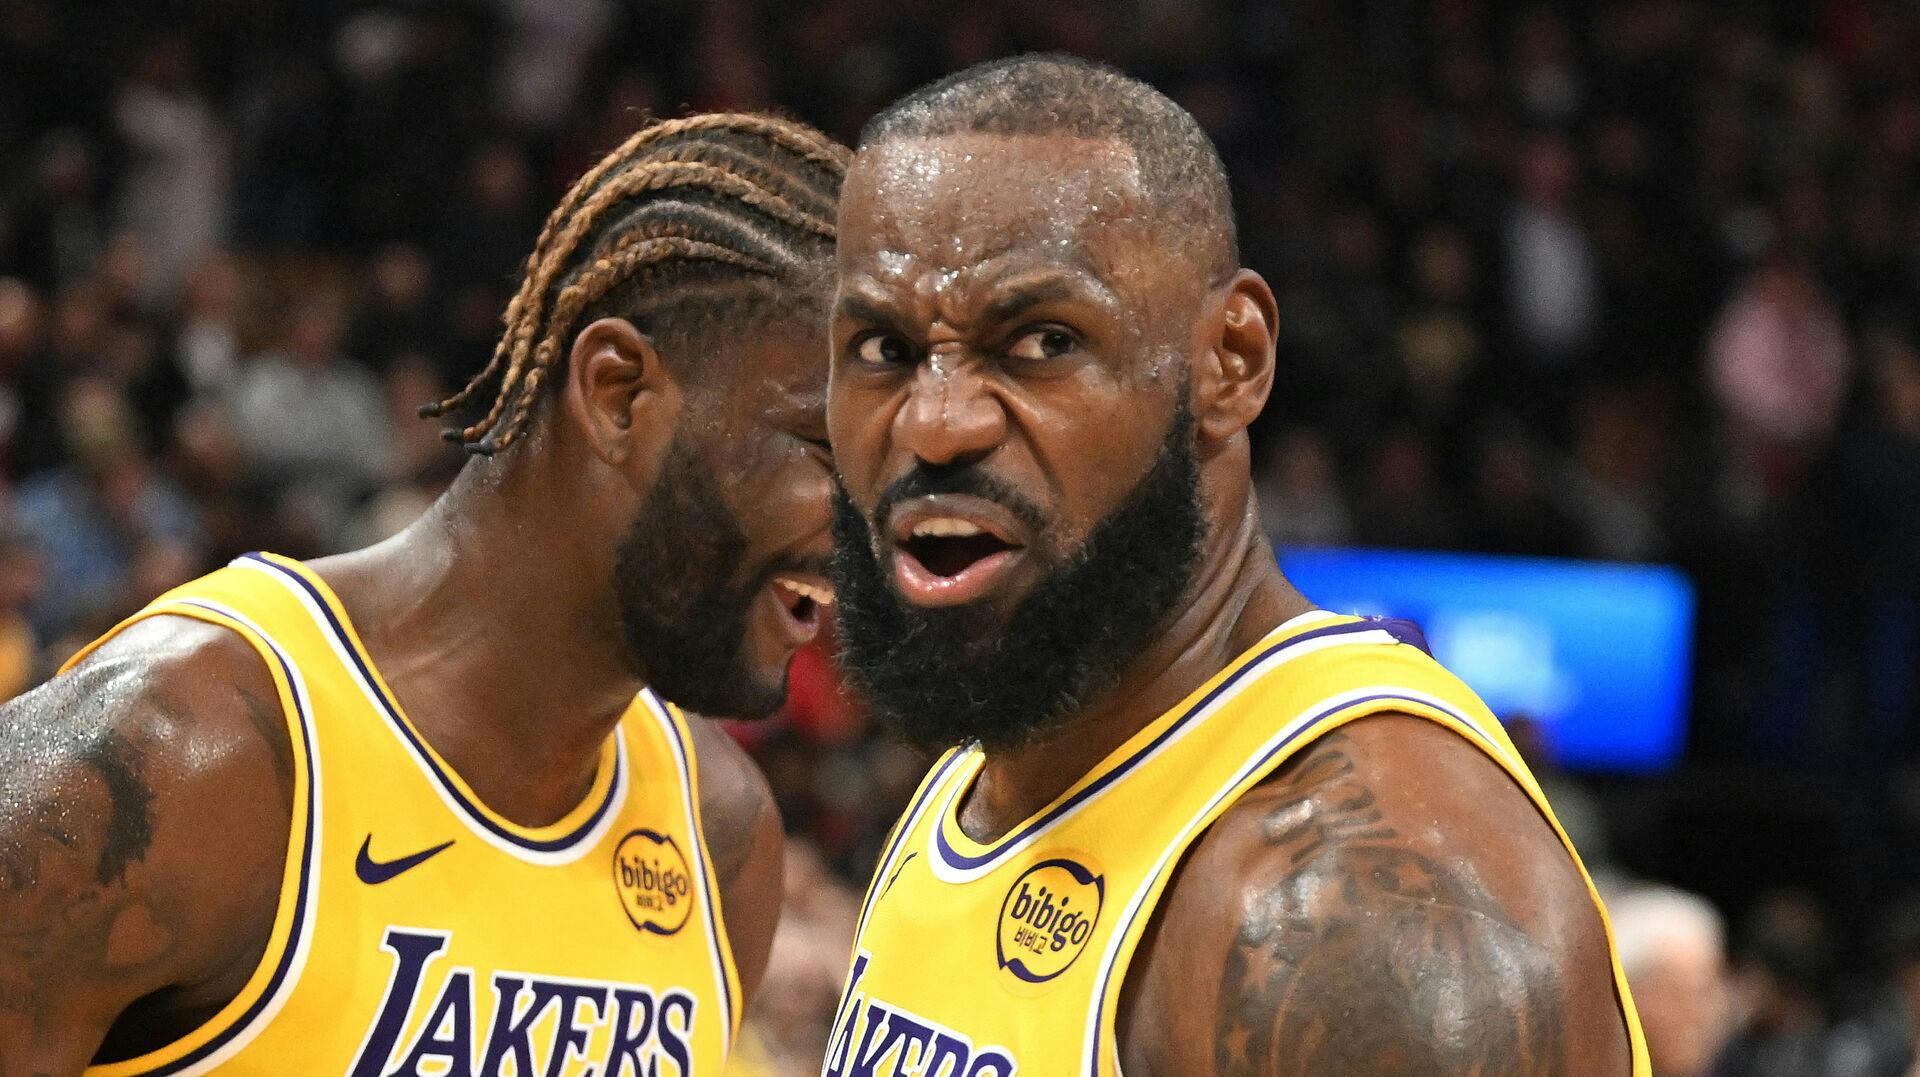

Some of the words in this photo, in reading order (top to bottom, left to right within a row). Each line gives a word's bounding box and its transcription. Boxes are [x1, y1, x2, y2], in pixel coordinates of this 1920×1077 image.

[620, 855, 687, 906] bibigo
[1010, 882, 1090, 952] bibigo
[342, 928, 696, 1077] LAKERS
[824, 953, 1015, 1077] AKE
